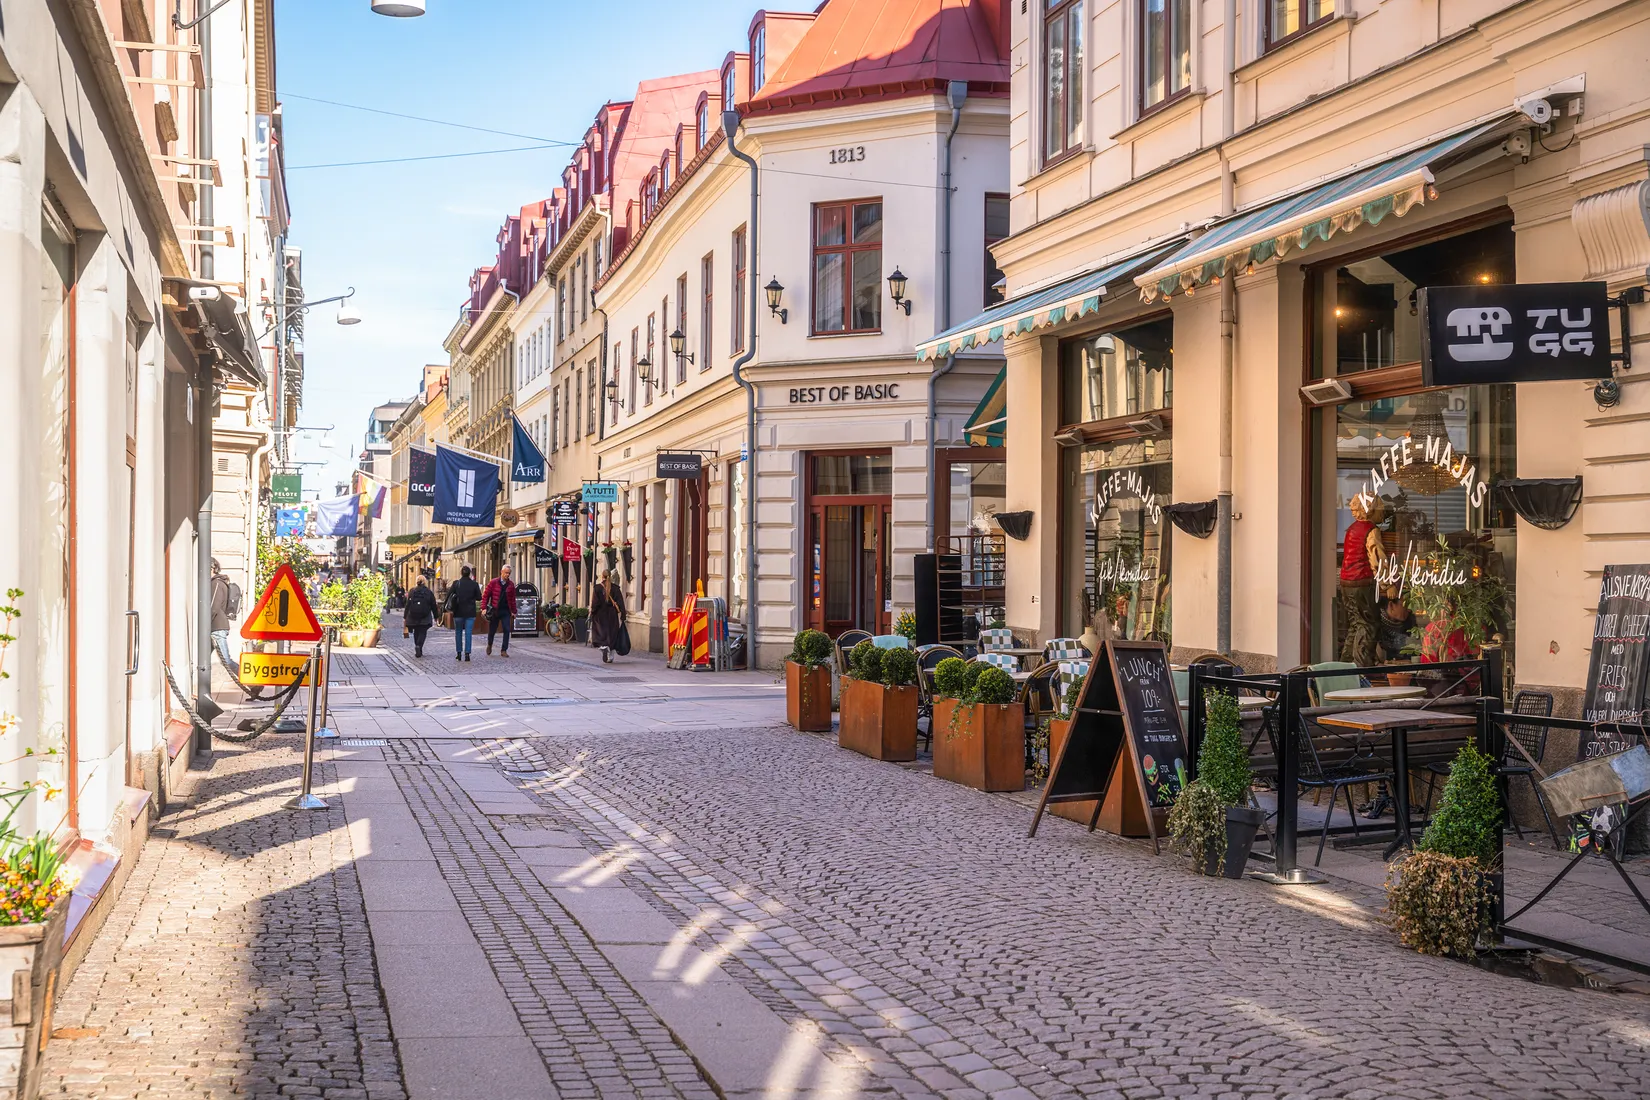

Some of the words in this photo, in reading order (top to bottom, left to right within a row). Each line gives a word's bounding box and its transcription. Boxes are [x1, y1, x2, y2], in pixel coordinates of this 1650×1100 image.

[829, 146, 865, 164] 1813
[789, 387, 825, 403] BEST
[828, 385, 850, 401] OF
[854, 383, 899, 400] BASIC
[1358, 435, 1488, 513] KAFFE-MAJAS
[585, 487, 592, 495] A
[592, 487, 615, 495] TUTTI
[1090, 470, 1161, 527] KAFFE-MAJAS
[447, 511, 482, 519] INDEPENDENT
[1611, 644, 1624, 655] MED
[1121, 657, 1161, 682] LUNCH
[1599, 663, 1627, 688] FRIES
[1605, 692, 1616, 702] OCH
